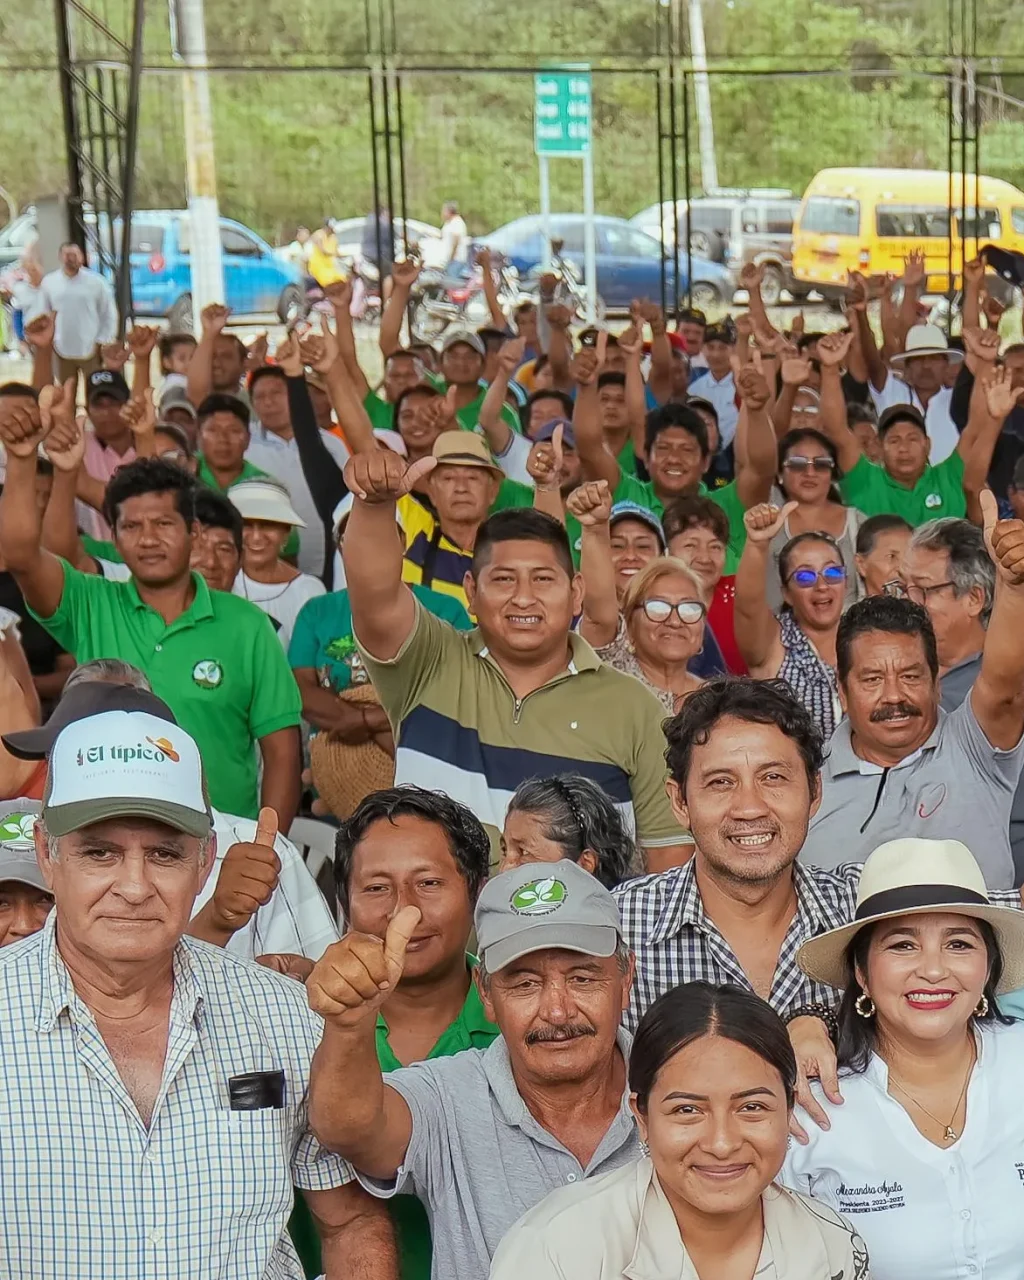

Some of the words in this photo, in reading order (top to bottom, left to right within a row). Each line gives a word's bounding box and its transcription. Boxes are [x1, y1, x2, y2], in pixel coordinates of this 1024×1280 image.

[87, 746, 104, 762] El
[111, 744, 165, 762] típico
[836, 1182, 876, 1195] Alexandra
[877, 1180, 903, 1197] Ayala
